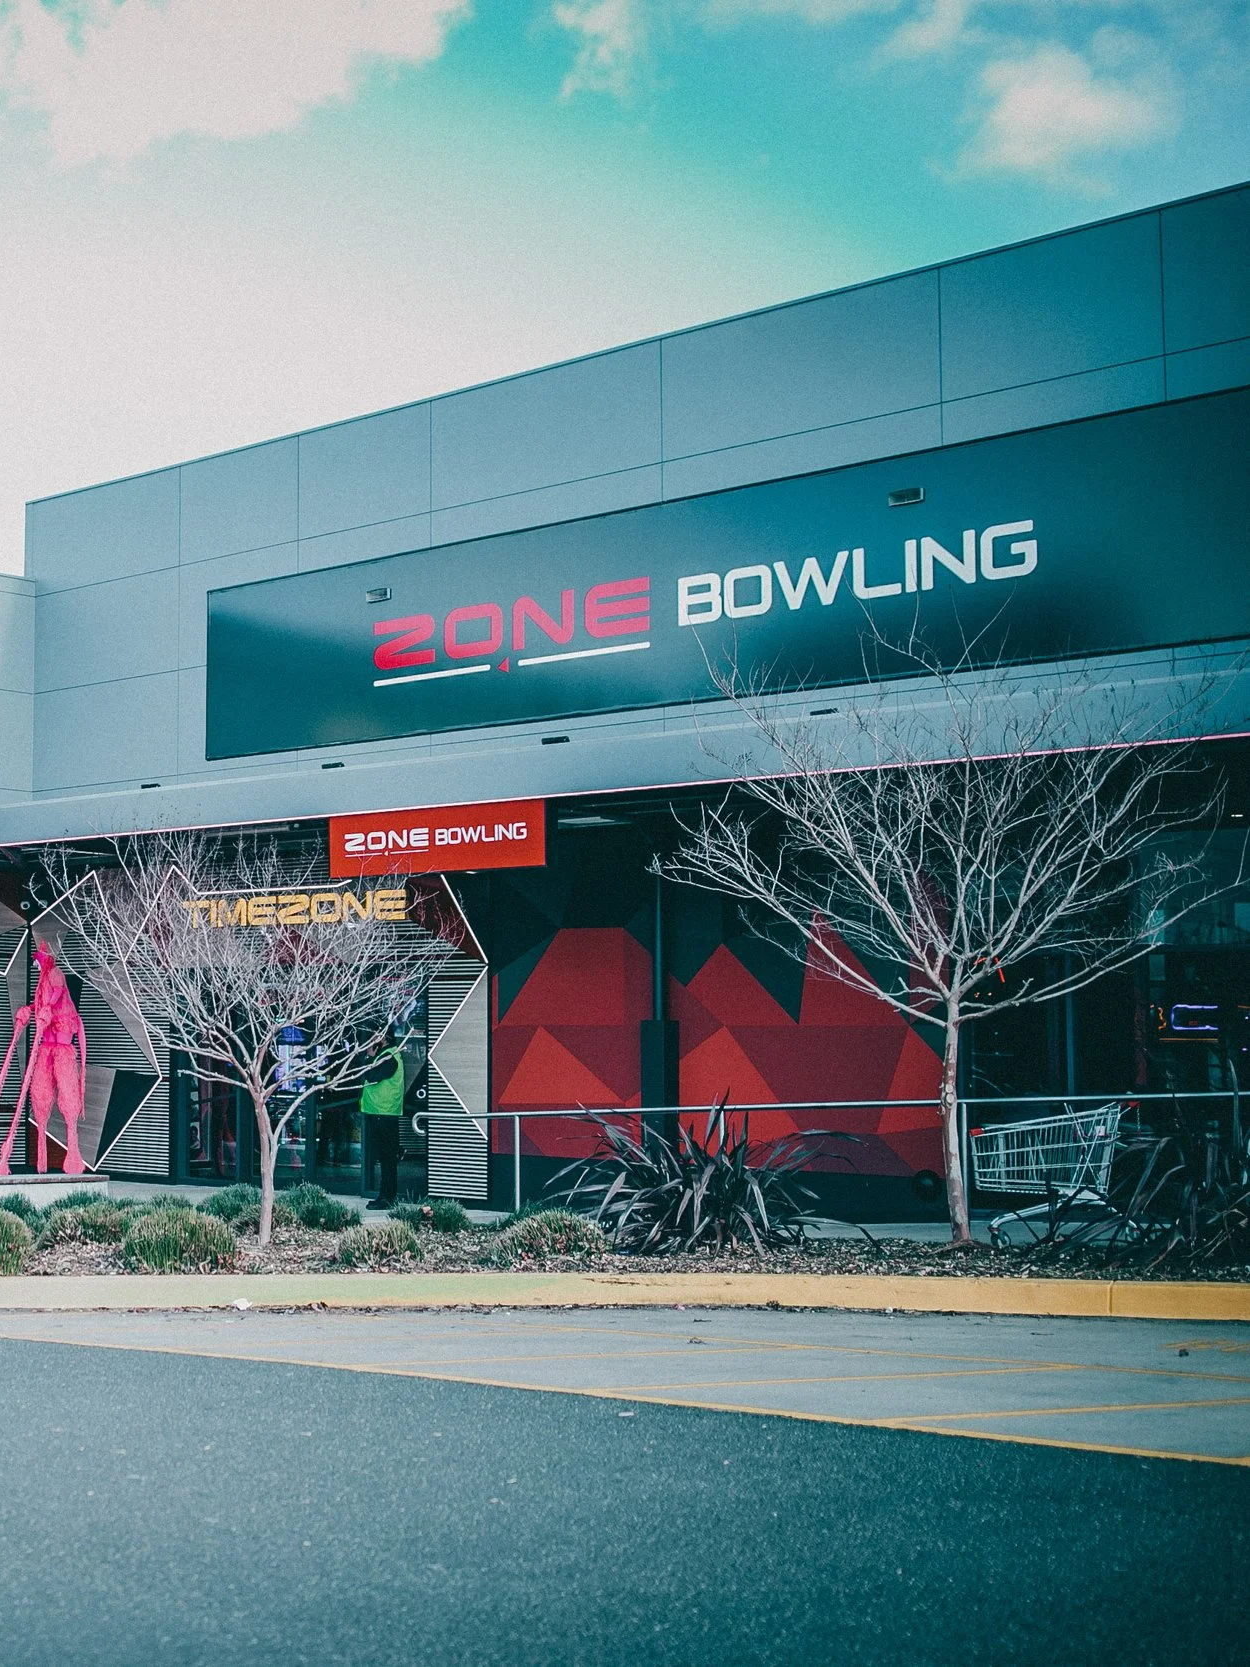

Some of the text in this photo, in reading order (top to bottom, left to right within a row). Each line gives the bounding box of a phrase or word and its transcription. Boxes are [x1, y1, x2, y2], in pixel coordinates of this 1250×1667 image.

[373, 519, 1038, 671] ZONE BOWLING
[344, 822, 527, 852] ZONE BOWLING
[182, 889, 408, 929] TIMEZONE
